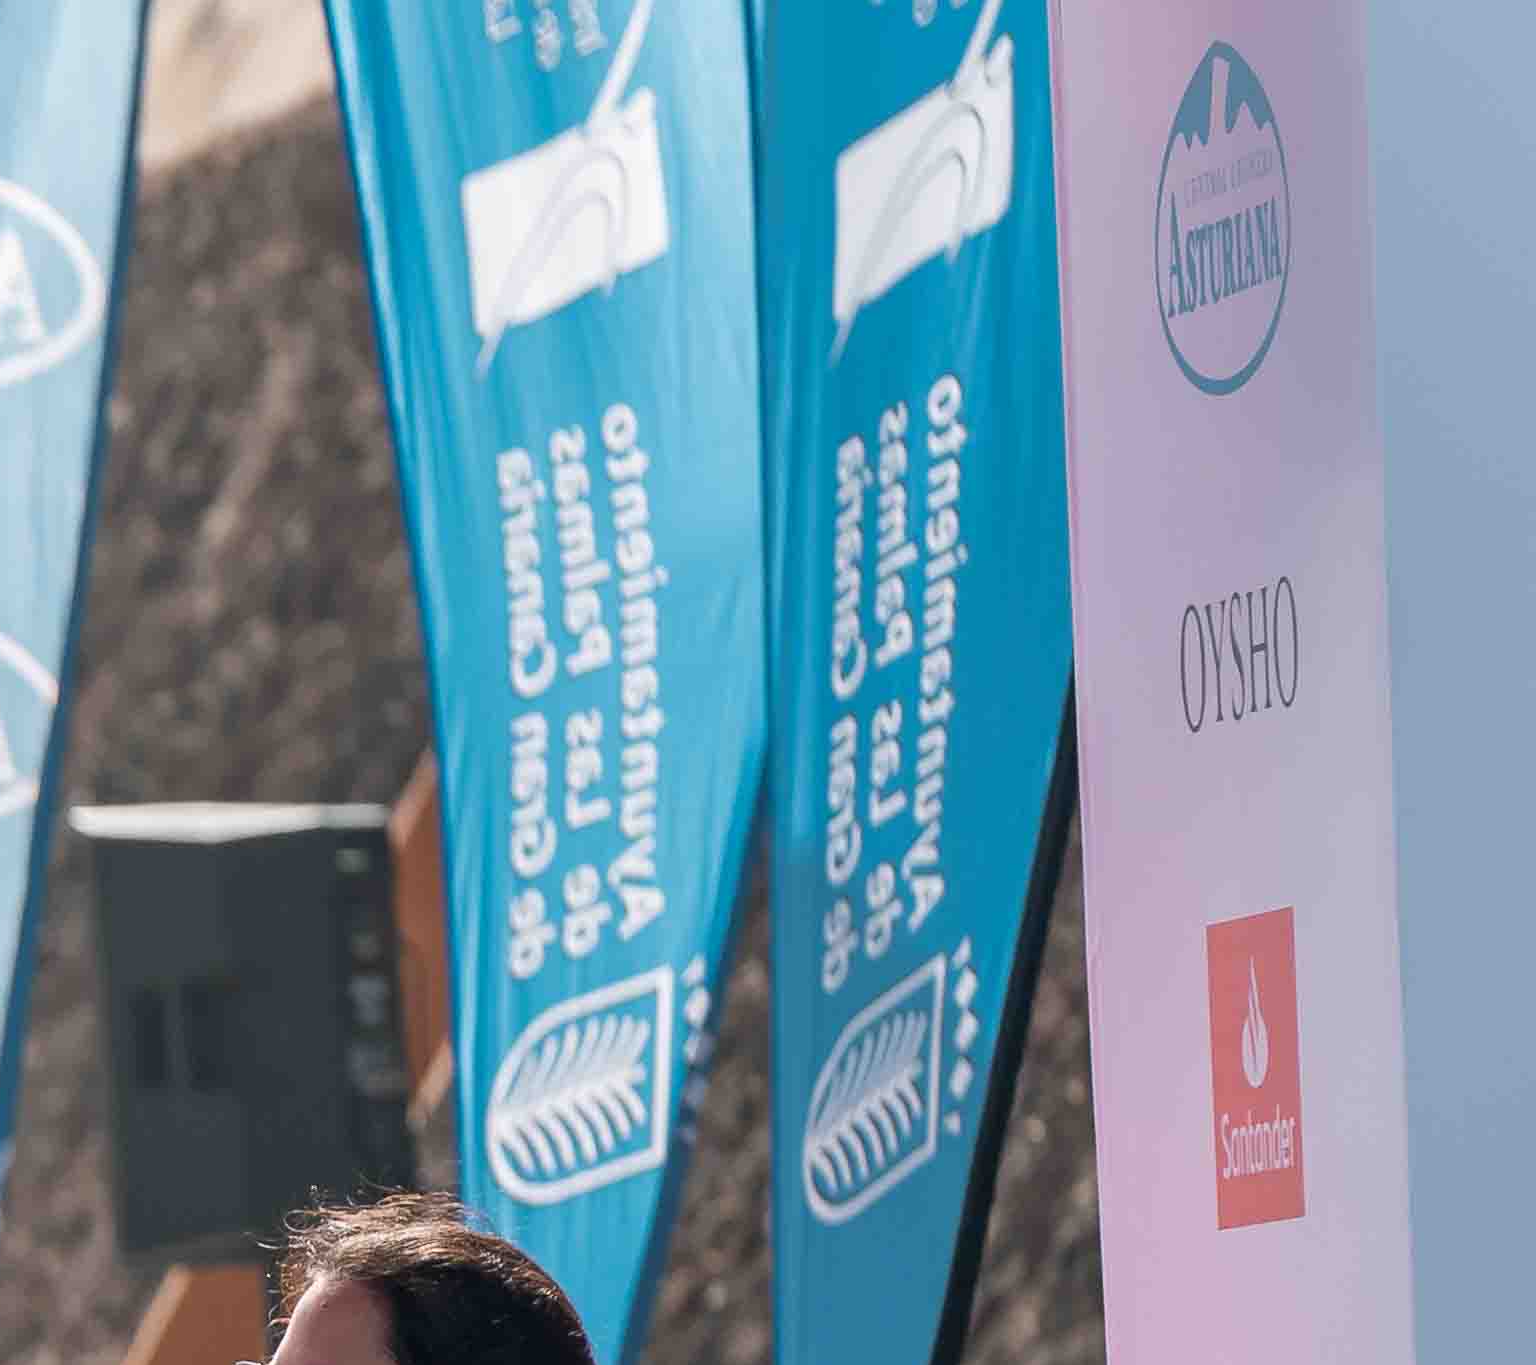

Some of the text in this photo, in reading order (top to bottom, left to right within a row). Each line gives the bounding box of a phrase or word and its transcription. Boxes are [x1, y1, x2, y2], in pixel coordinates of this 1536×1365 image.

[1167, 192, 1283, 318] ASTURIANA
[1181, 576, 1298, 733] OYSHO
[1221, 1104, 1295, 1180] Santander
